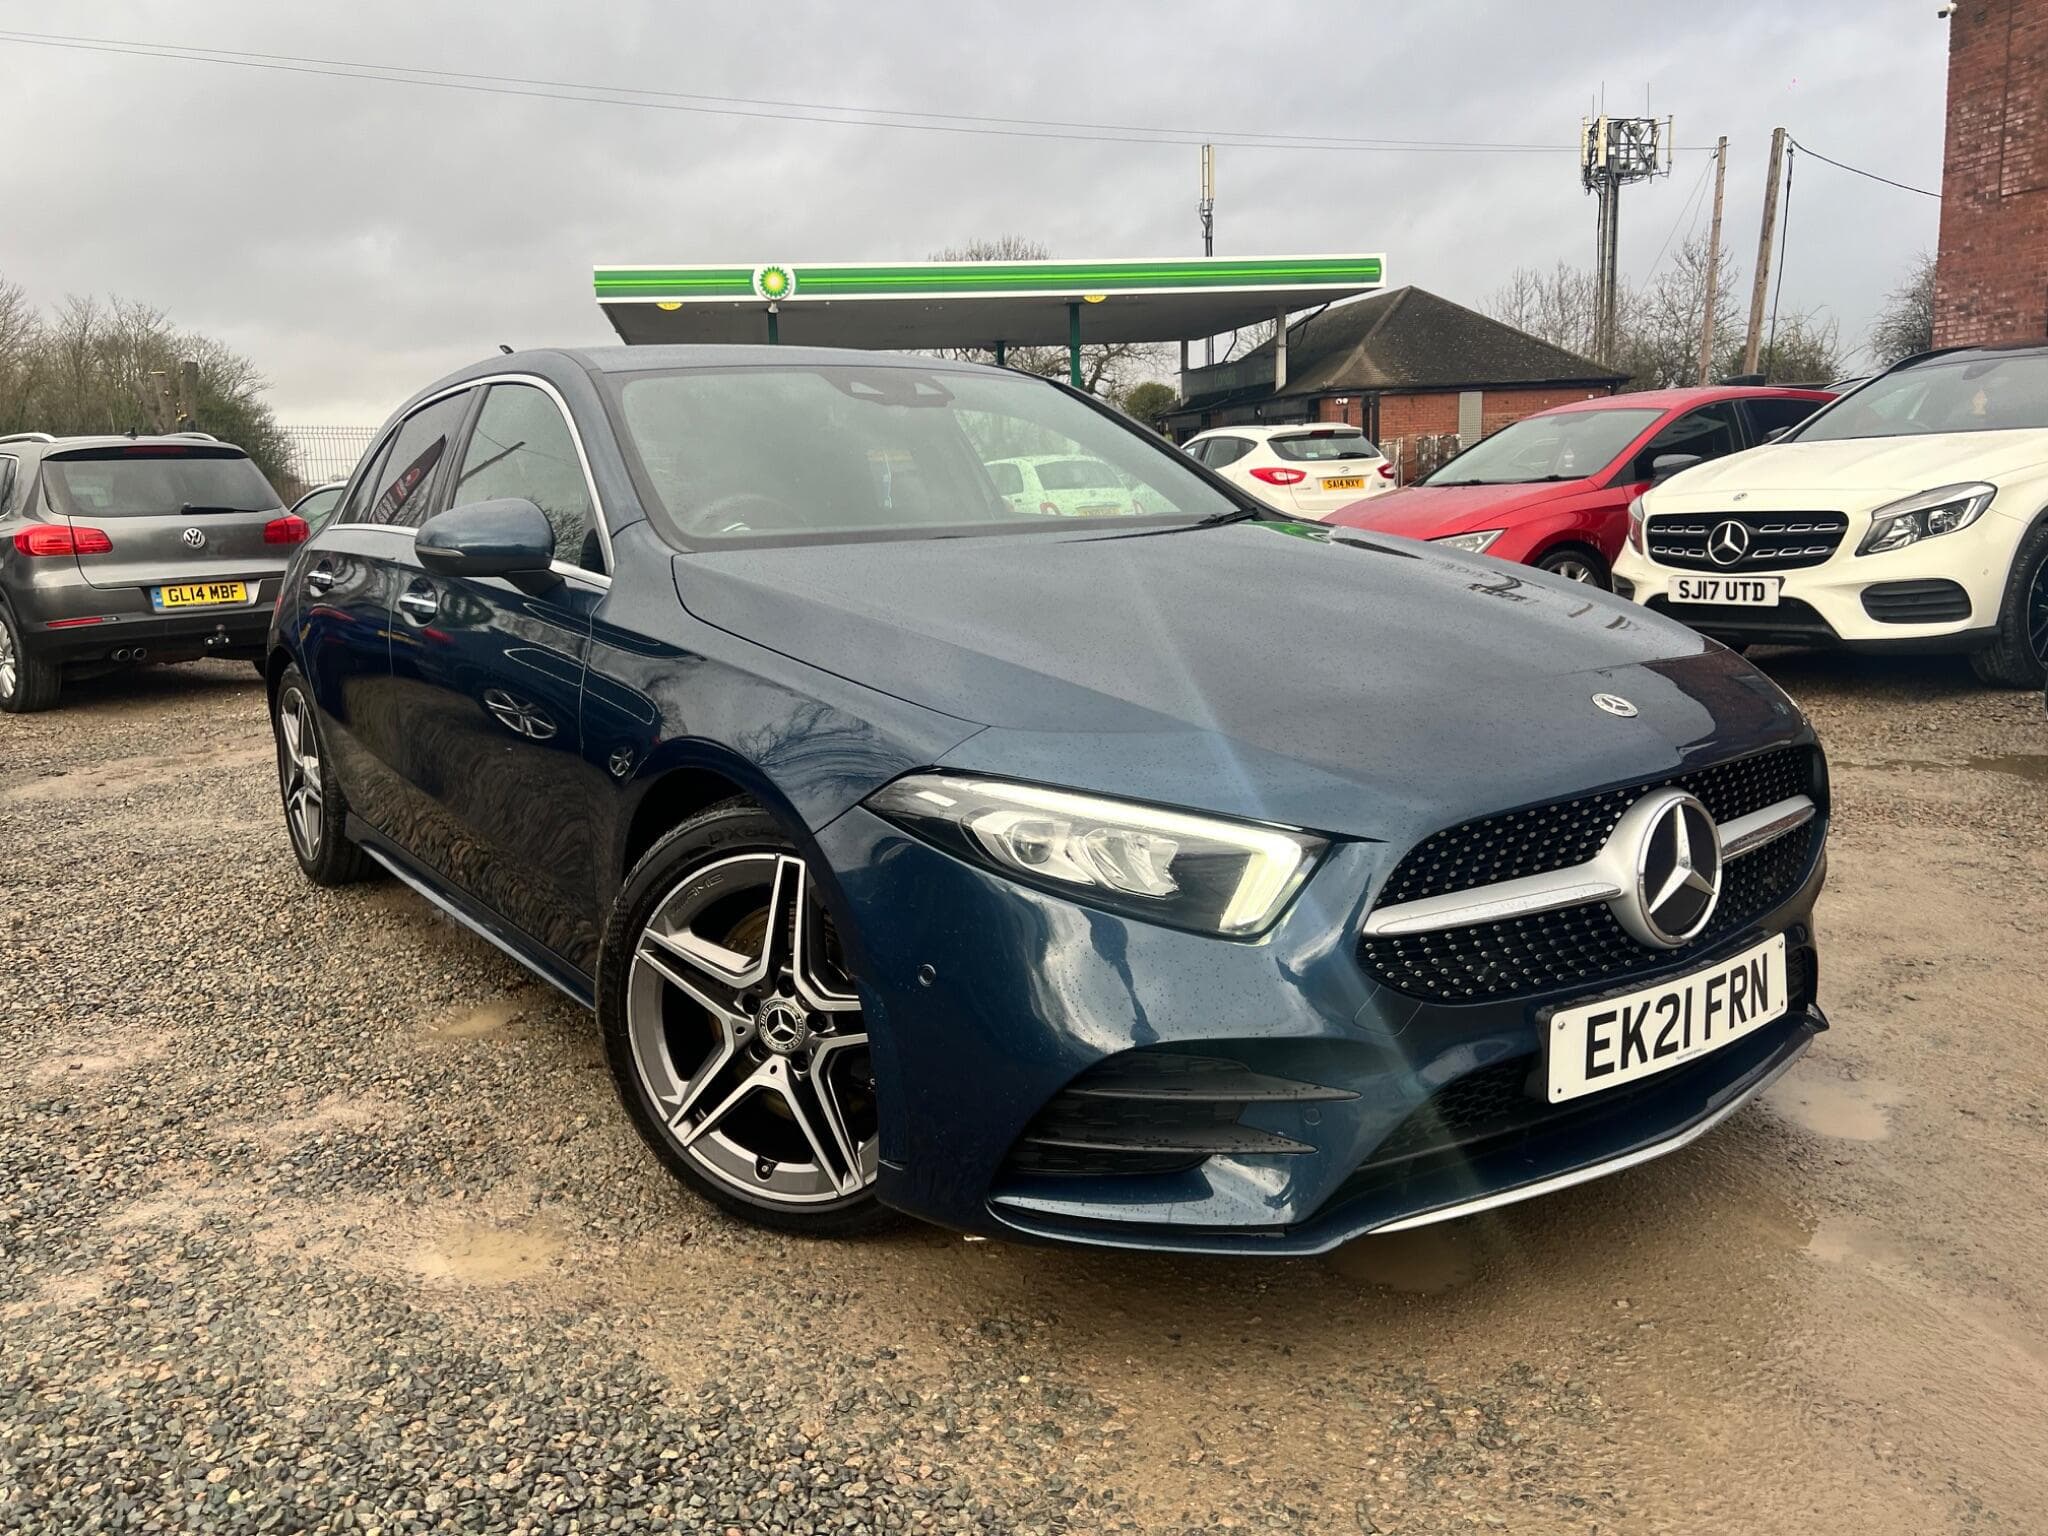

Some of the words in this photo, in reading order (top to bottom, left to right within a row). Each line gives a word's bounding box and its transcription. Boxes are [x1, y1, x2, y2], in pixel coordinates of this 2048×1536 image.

[1327, 480, 1342, 489] SA14
[1344, 478, 1360, 488] NXY
[167, 587, 205, 602] GL14
[209, 584, 238, 599] MBF
[1679, 580, 1719, 600] SJ17
[1725, 582, 1765, 601] UTD
[1585, 986, 1693, 1081] EK21
[1704, 952, 1768, 1041] FRN
